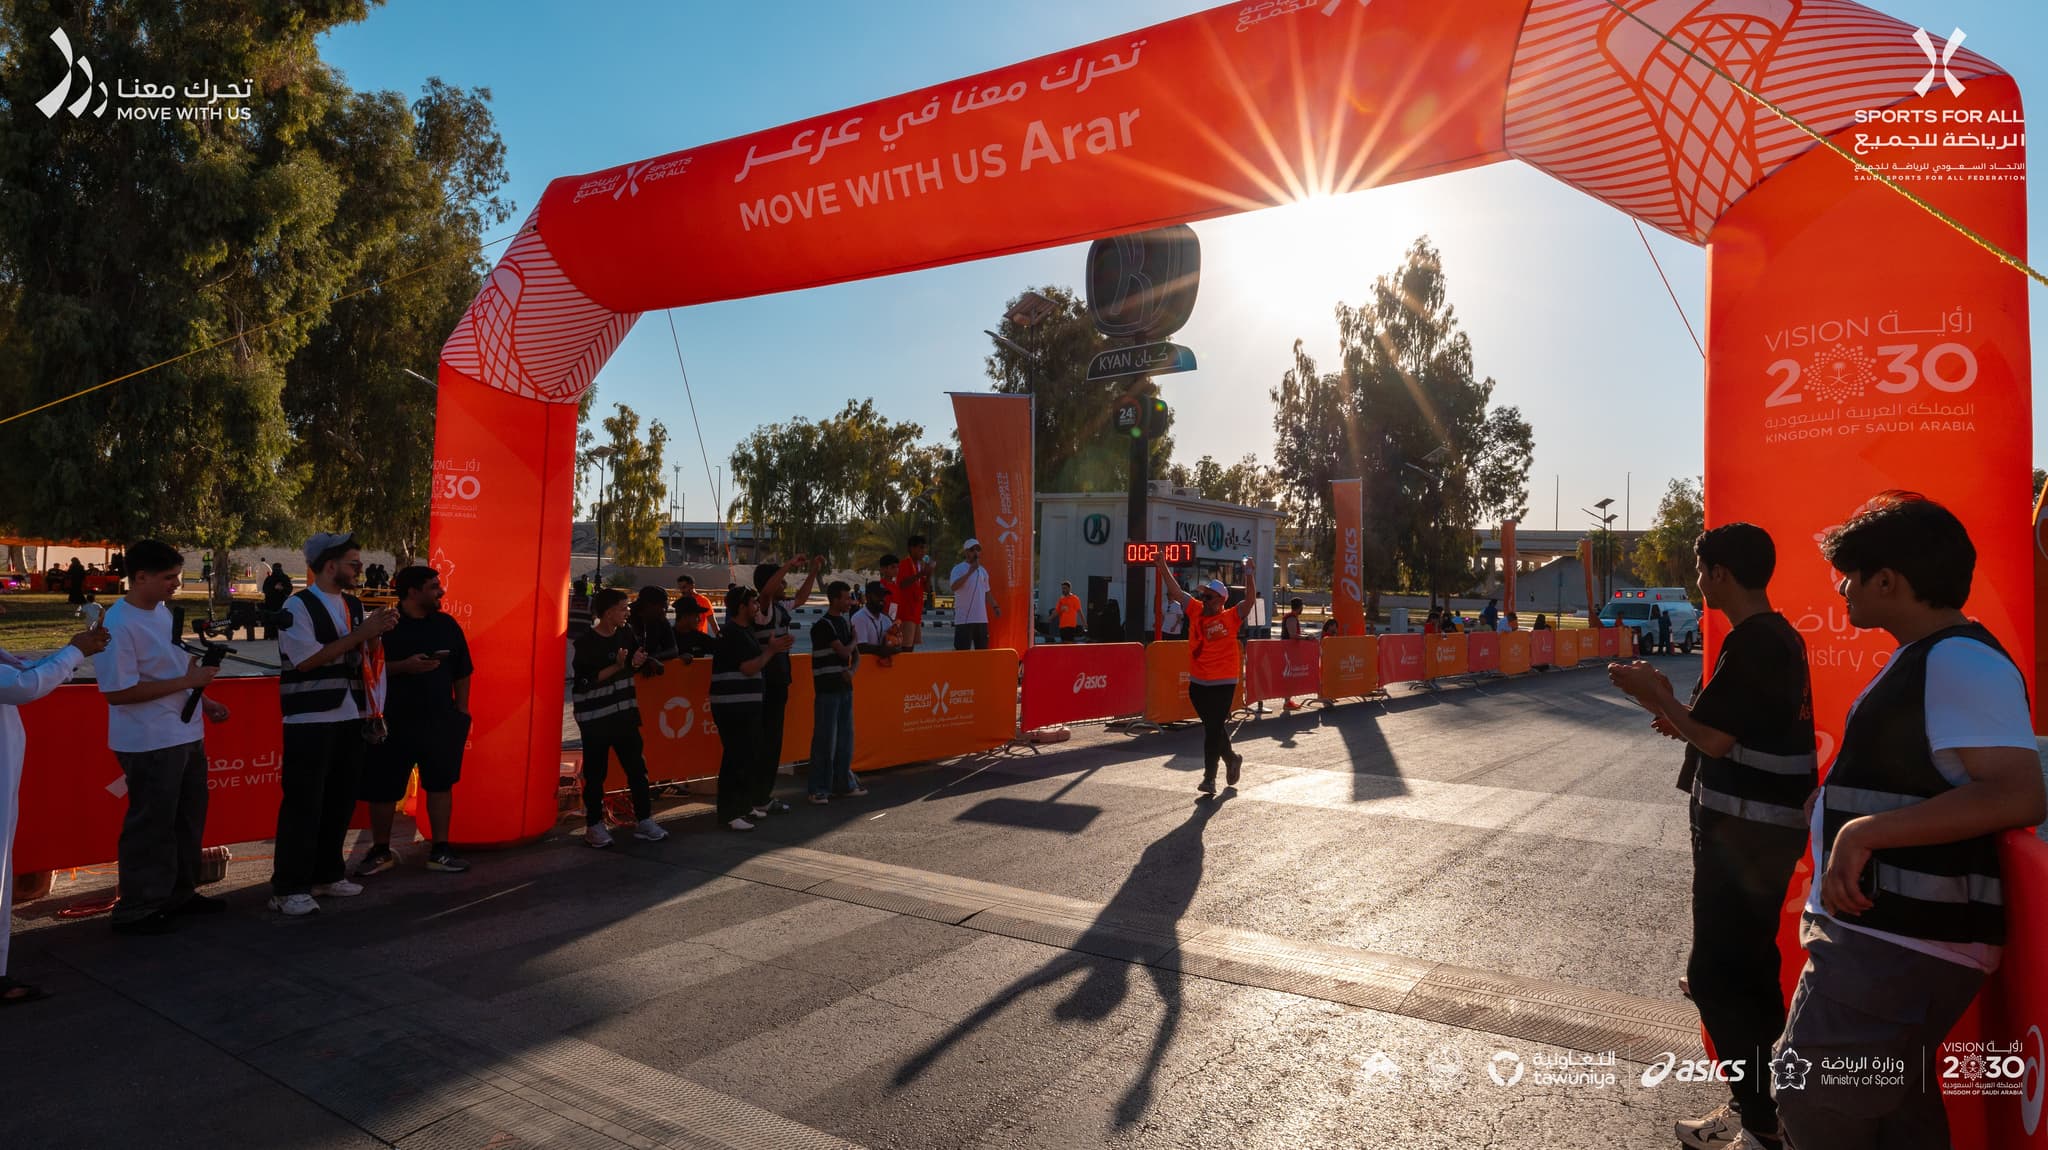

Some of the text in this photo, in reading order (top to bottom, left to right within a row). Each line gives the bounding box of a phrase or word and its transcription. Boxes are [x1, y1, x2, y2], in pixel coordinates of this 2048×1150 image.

[734, 39, 1147, 183] تحرك معنا في عرعر
[643, 165, 687, 182] FOR ALL
[648, 157, 692, 174] SPORTS
[739, 108, 1141, 231] MOVE WITH US Arar
[1764, 316, 1869, 352] VISION
[1099, 351, 1131, 370] KYAN
[1134, 345, 1169, 368] كيان
[1119, 407, 1133, 419] 24
[1764, 401, 1975, 429] المملكة العربية السعودية
[1766, 421, 1976, 444] KINGDOM OF SAUDI ARABIA
[1176, 521, 1206, 546] KYAN
[1808, 645, 1864, 672] istry
[1084, 675, 1107, 688] asics
[207, 776, 240, 790] OVE
